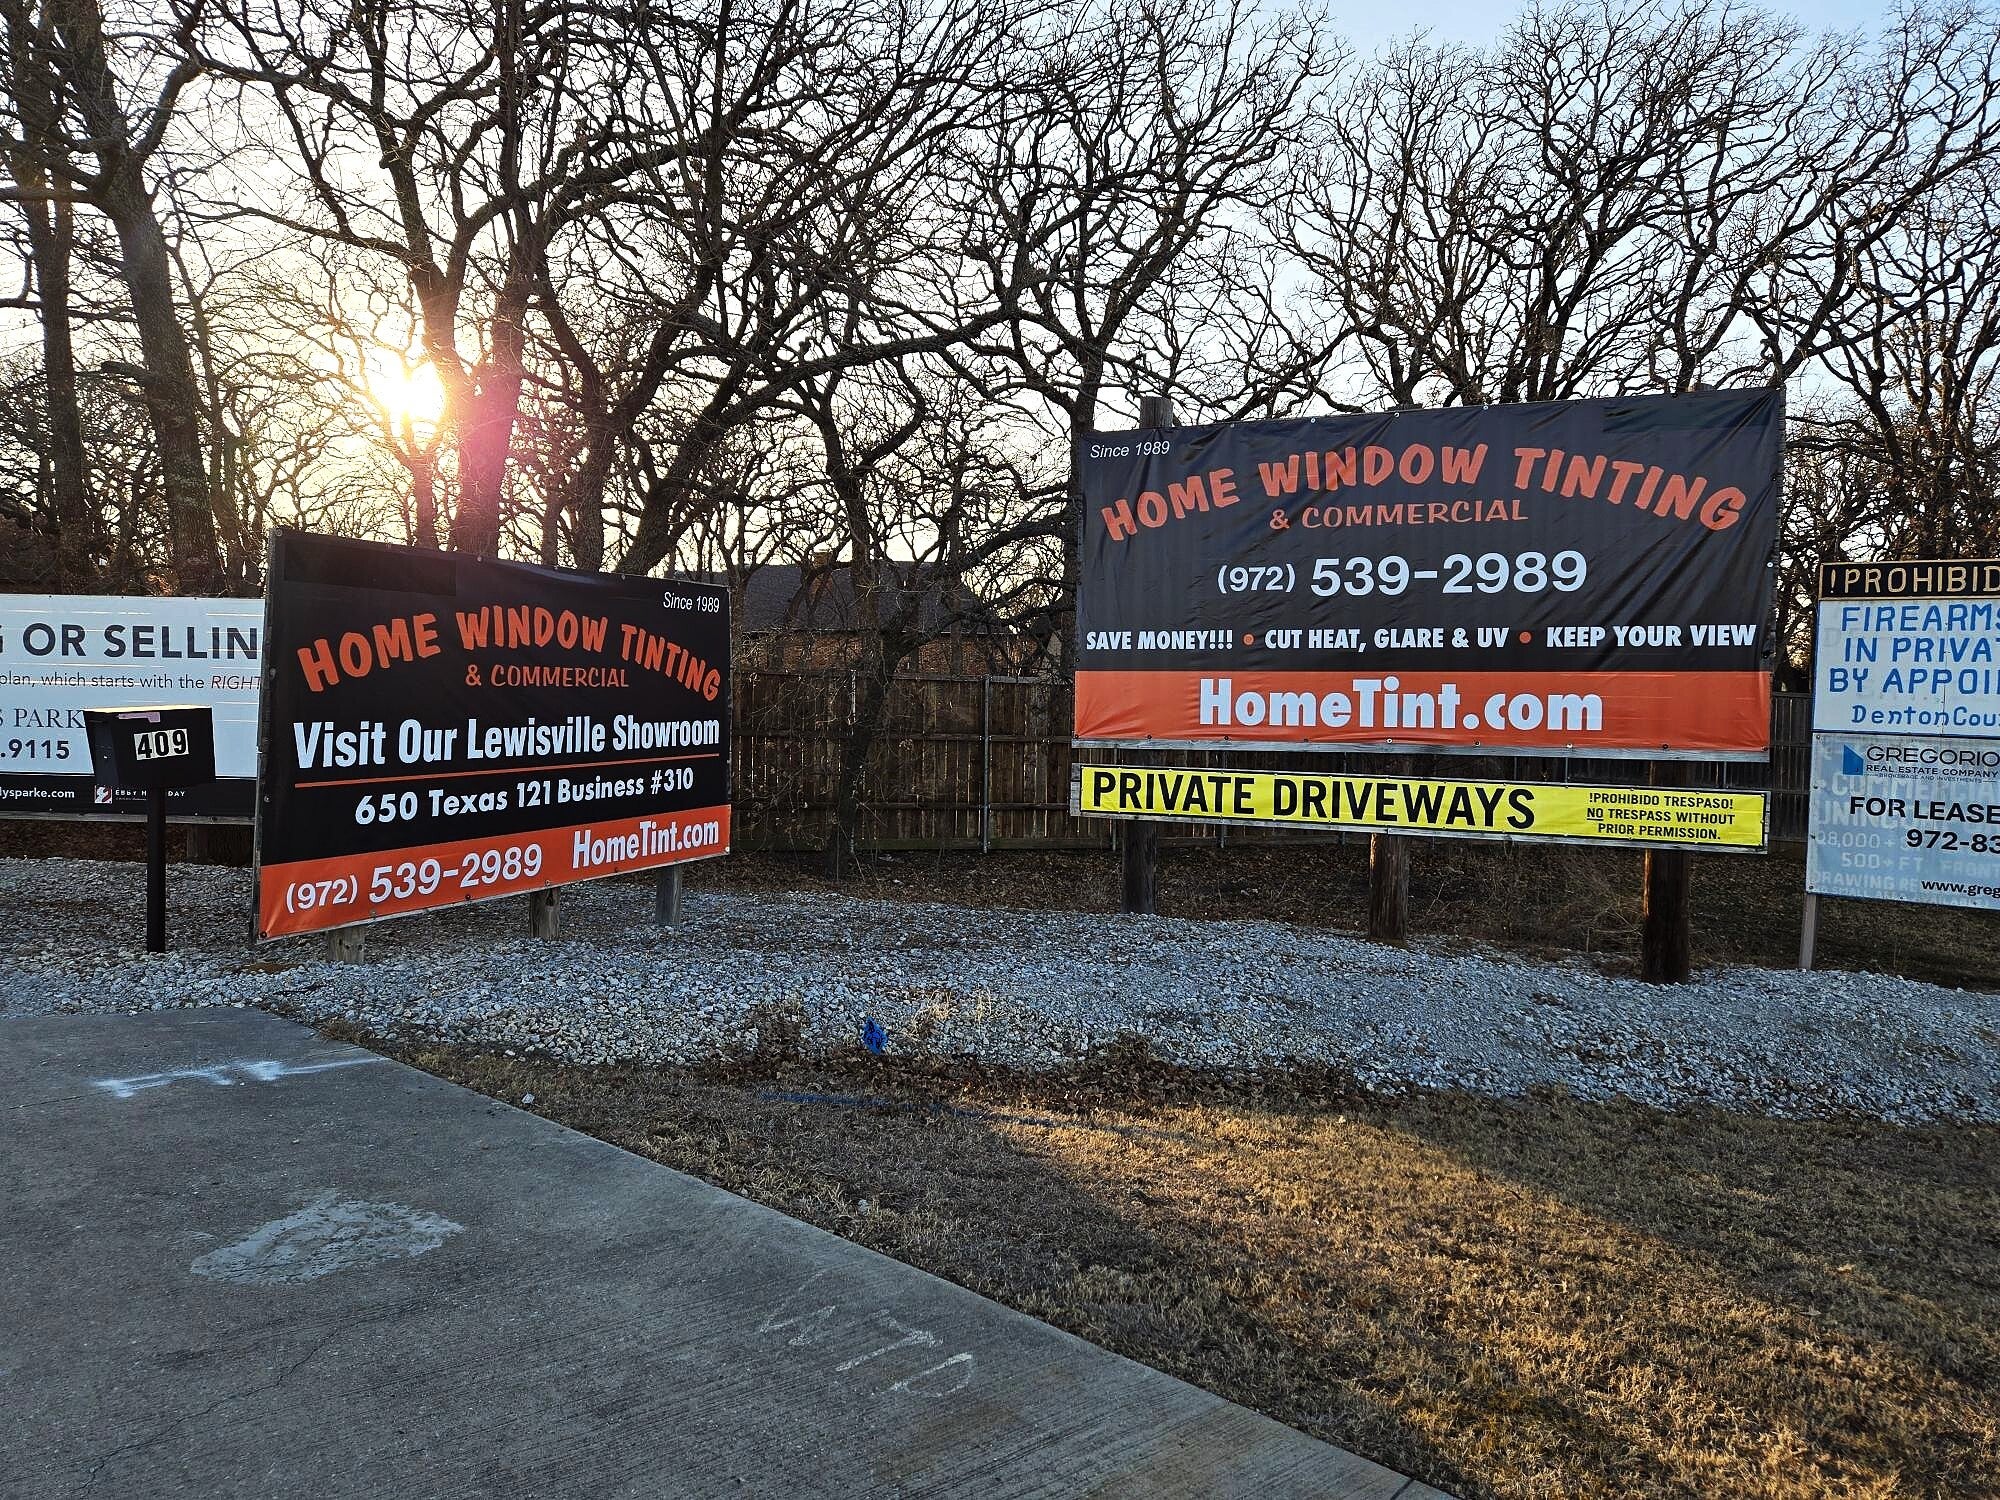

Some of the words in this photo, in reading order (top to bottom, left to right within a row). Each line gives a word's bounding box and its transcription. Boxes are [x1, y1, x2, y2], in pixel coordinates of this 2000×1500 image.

[1090, 443, 1130, 459] Since
[1135, 440, 1170, 457] 1989
[1101, 468, 1241, 542] HOME
[1258, 443, 1488, 497] WINDOW
[1514, 447, 1747, 531] TINTING
[1269, 509, 1291, 530] &
[1302, 499, 1528, 529] COMMERCIAL
[1217, 563, 1296, 594] (972)
[1310, 550, 1587, 597] 539-2989
[662, 591, 694, 611] Since
[696, 594, 720, 613] 1989
[23, 622, 87, 657] OR
[104, 624, 258, 660] SELLIN
[297, 613, 441, 693] HOME
[456, 605, 609, 652] WINDOW
[620, 623, 721, 701] TINTING
[1086, 630, 1131, 650] SAVE
[1137, 629, 1233, 650] MONEY!!!
[1264, 629, 1302, 649] CUT
[1308, 628, 1367, 653] HEAT,
[1374, 627, 1444, 649] GLARE
[1451, 627, 1470, 648] &
[1477, 626, 1510, 648] UV
[1546, 626, 1606, 648] KEEP
[1613, 625, 1682, 647] YOUR
[1689, 624, 1757, 647] VIEW
[1845, 637, 1878, 662] IN
[1892, 637, 2000, 663] PRIVA
[0, 670, 35, 687] plan,
[41, 671, 86, 687] which
[91, 673, 135, 688] starts
[140, 672, 174, 689] with
[179, 673, 205, 689] the
[211, 675, 262, 690] RIGHT
[465, 664, 482, 687] &
[490, 664, 630, 689] COMMERCIAL
[1830, 668, 1869, 693] BY
[1882, 668, 2000, 695] APPOI
[1199, 676, 1603, 731] HomeTint.com
[1851, 704, 2000, 727] DentonCou
[138, 729, 187, 758] 409
[293, 719, 387, 770] Visit
[398, 718, 458, 763] Our
[467, 715, 606, 759] Lewisville
[612, 714, 720, 751] Showroom
[1866, 746, 2000, 768] GREGORIO
[1866, 765, 1895, 773] REAL
[1899, 766, 1939, 775] ESTATE
[1942, 768, 1999, 778] COMPANY
[354, 792, 418, 825] 650
[428, 788, 508, 818] Texas
[516, 781, 551, 808] 121
[557, 775, 644, 804] Business
[651, 767, 694, 795] #310
[1093, 771, 1256, 815] PRIVATE
[1273, 779, 1535, 830] DRIVEWAYS
[1589, 793, 1660, 806] !PROHIBIDO
[1664, 795, 1734, 810] TRESPASO!
[1850, 796, 1906, 818] FOR
[1914, 800, 2000, 825] LEASE
[1587, 808, 1604, 819] NO
[1608, 808, 1672, 822] TRESPASS
[1675, 812, 1735, 825] WITHOUT
[1598, 823, 1635, 835] PRIOR
[1639, 825, 1721, 840] PERMISSION.
[285, 874, 358, 914] (972)
[368, 842, 543, 903] 539-2989
[572, 818, 720, 870] HomeTint.com
